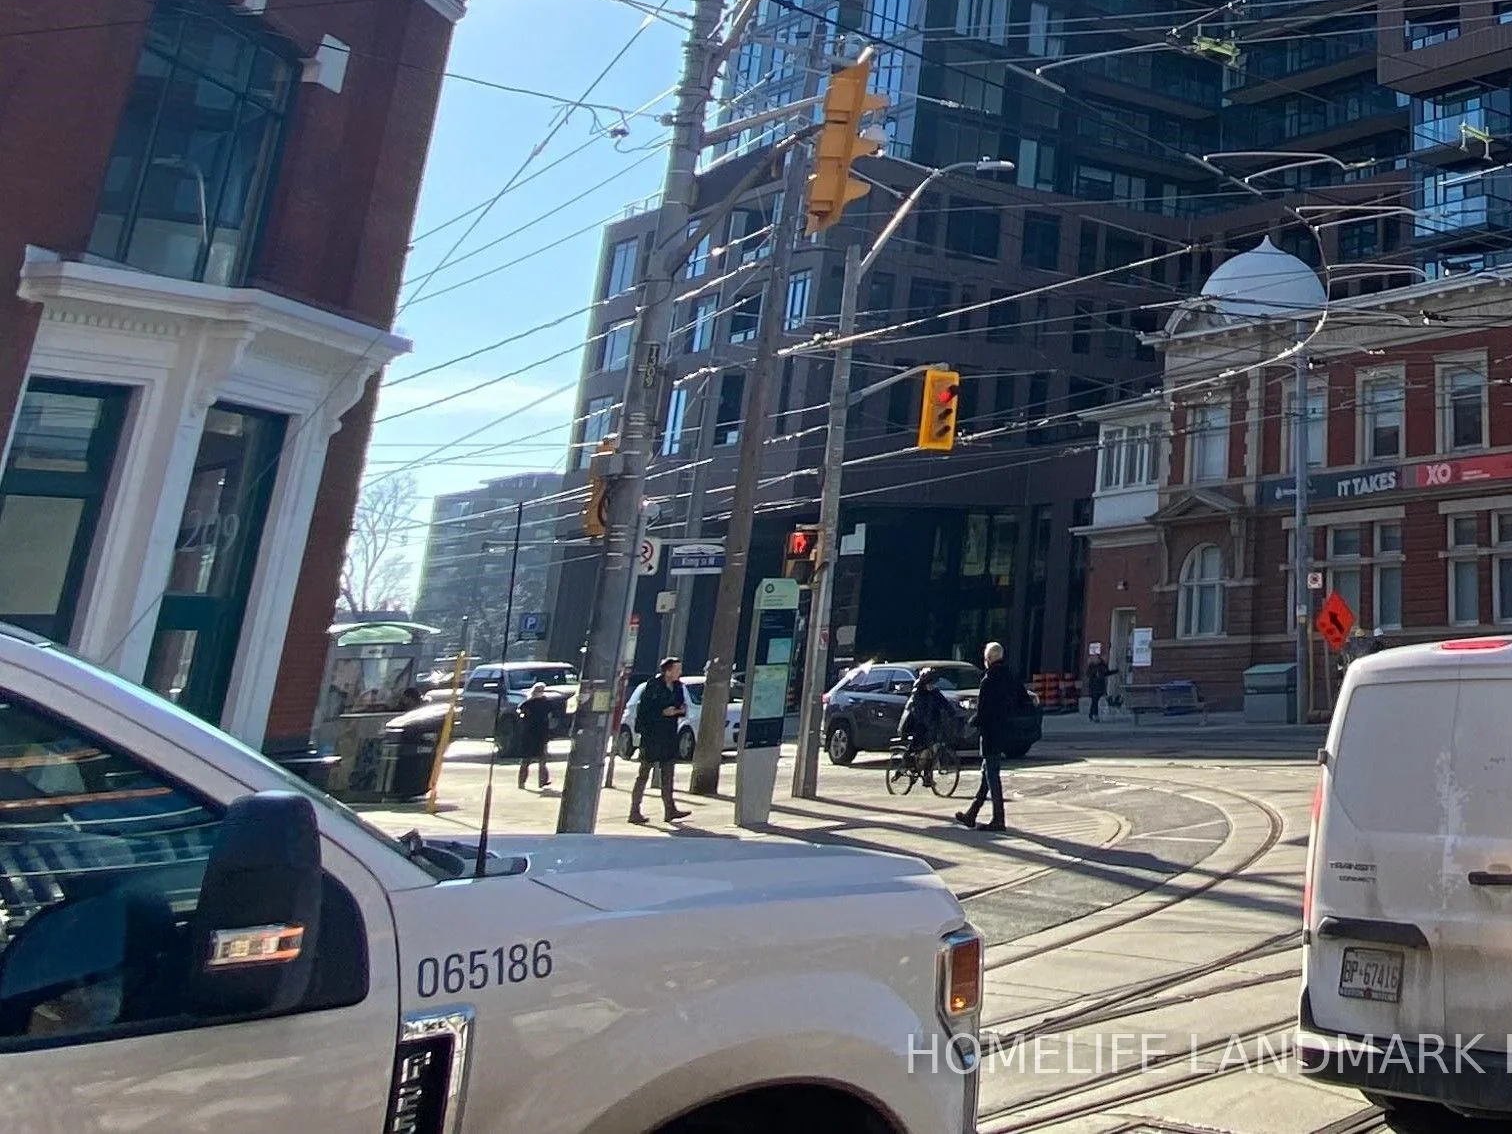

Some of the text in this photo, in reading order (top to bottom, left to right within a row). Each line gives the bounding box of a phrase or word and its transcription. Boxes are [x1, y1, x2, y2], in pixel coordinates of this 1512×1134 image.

[1337, 480, 1350, 497] IT
[1352, 471, 1397, 495] TAKES
[1426, 463, 1452, 485] XO
[526, 616, 536, 629] P
[417, 939, 552, 998] 065186
